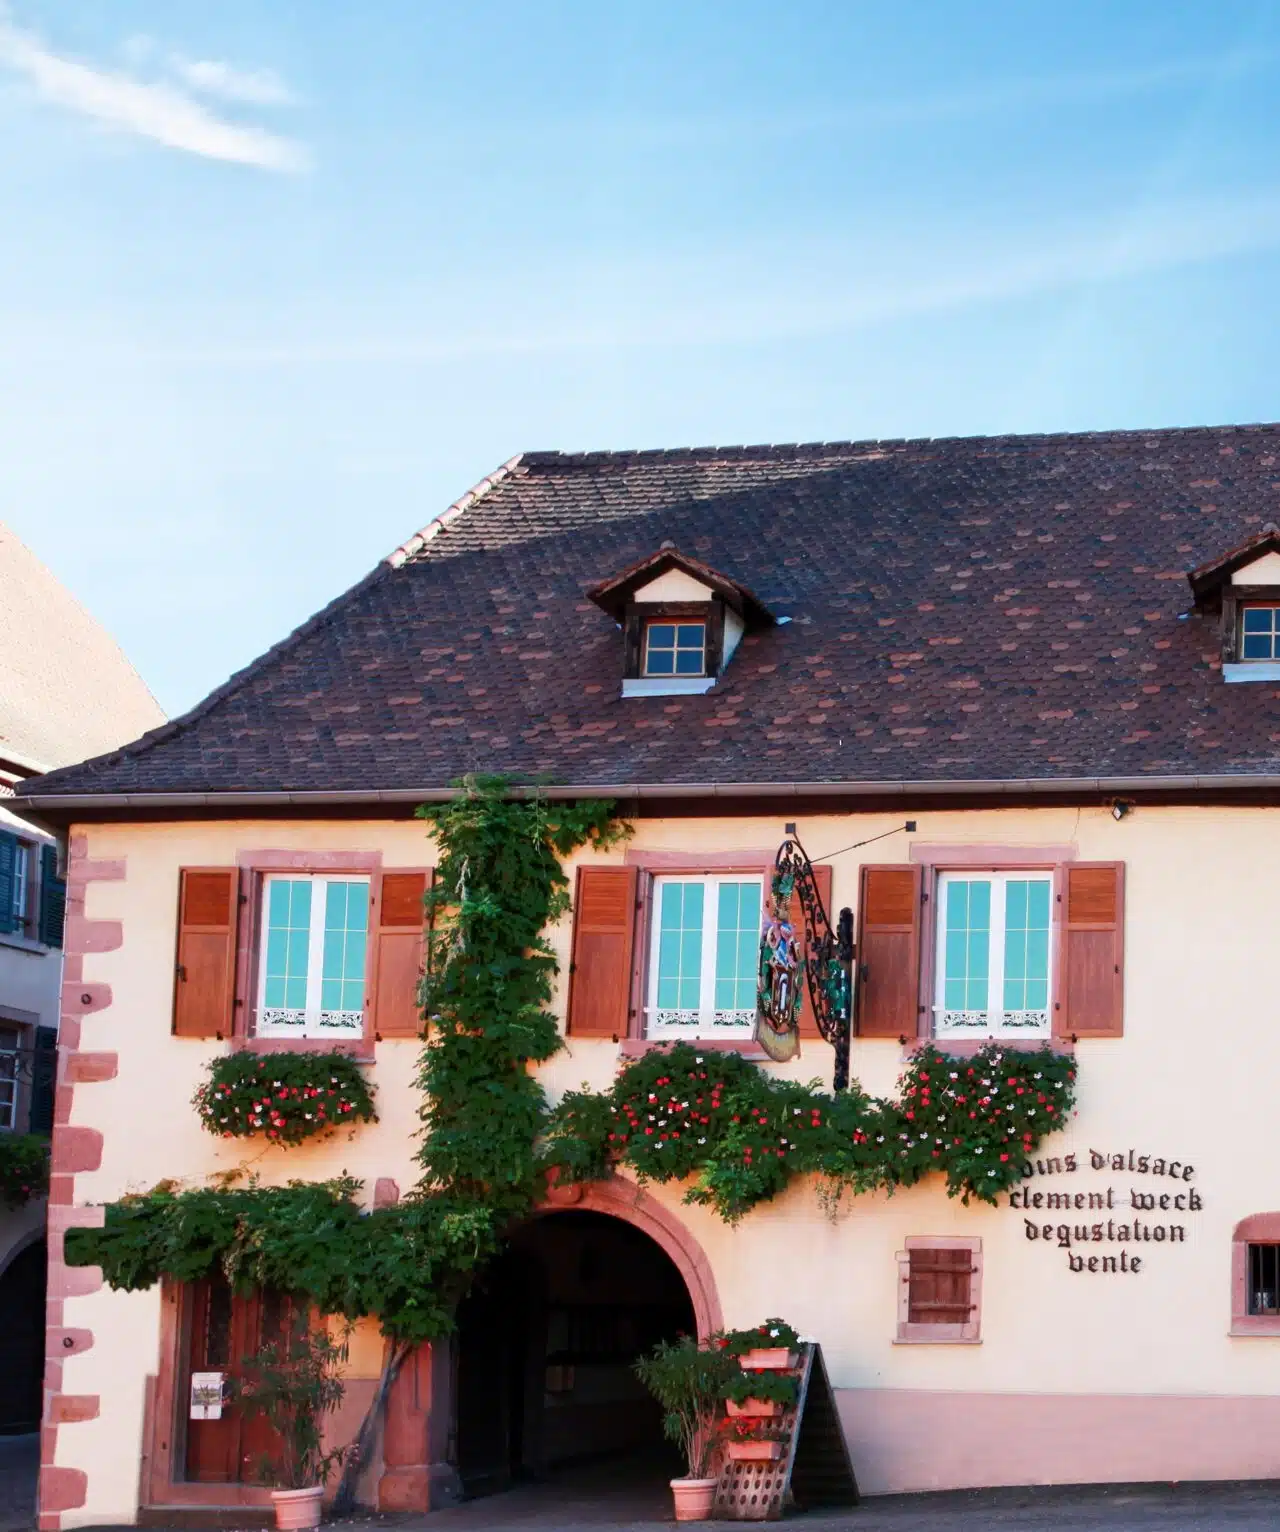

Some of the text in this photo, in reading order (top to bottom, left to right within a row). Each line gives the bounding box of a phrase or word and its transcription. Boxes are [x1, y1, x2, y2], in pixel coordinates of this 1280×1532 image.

[1009, 1186, 1204, 1211] clement weck
[1024, 1217, 1185, 1248] degustation
[1068, 1250, 1143, 1273] vente
